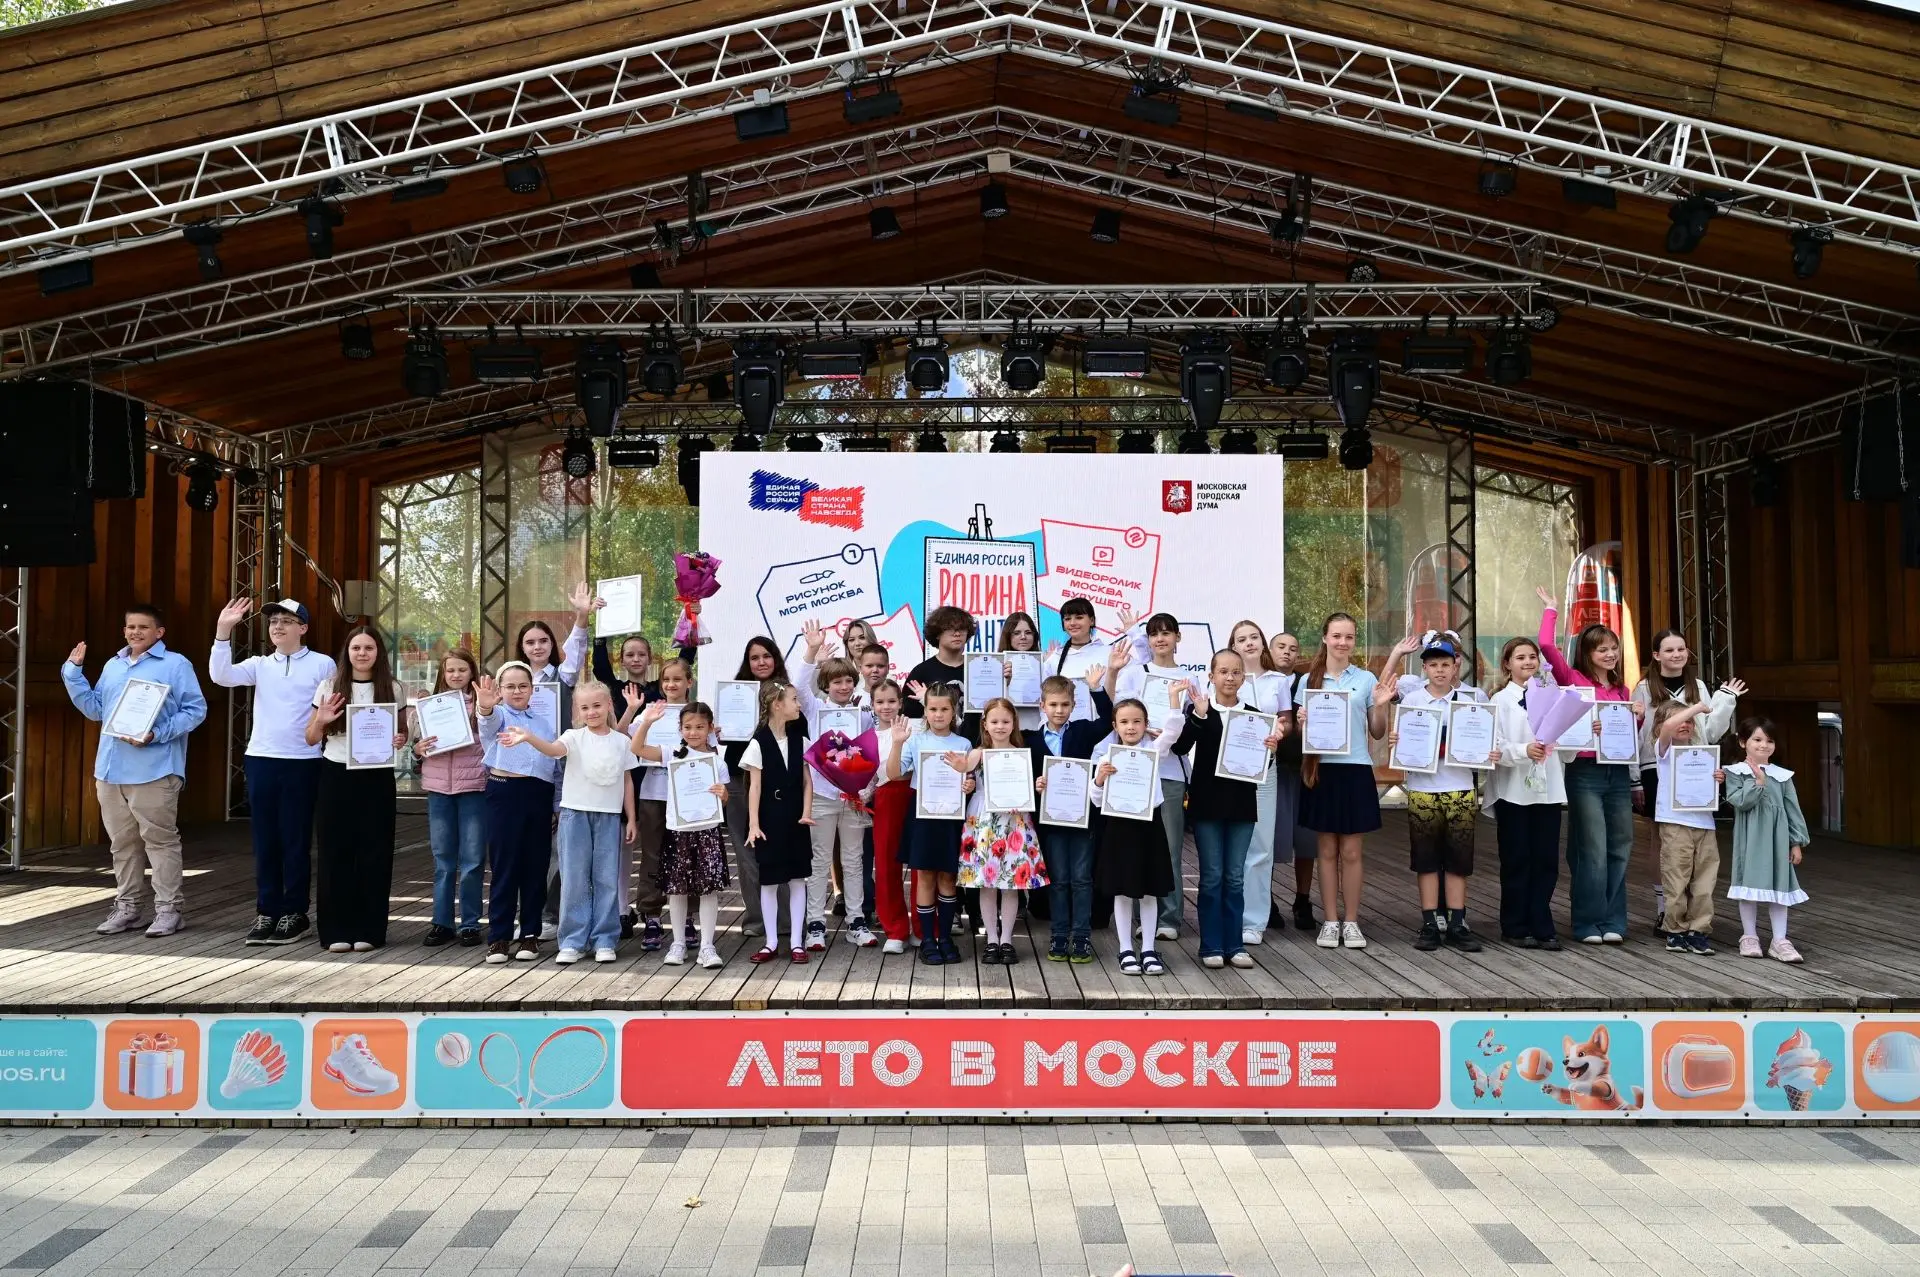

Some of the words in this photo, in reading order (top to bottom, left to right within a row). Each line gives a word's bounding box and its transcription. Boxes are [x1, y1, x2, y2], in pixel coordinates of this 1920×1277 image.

[1196, 483, 1247, 491] МОСКОВСКАЯ
[1196, 492, 1241, 501] ГОРОДСКАЯ
[1196, 502, 1219, 511] ДУМА
[934, 551, 980, 566] ЕДИНАЯ
[982, 553, 1025, 567] РОССИЯ
[1055, 565, 1142, 591] ВИДЕОРОЛИК
[785, 580, 847, 604] РИСУНОК
[940, 567, 1027, 617] РОДИНА
[1069, 579, 1124, 598] МОСКВА
[778, 603, 808, 617] МОЯ
[810, 587, 865, 608] МОСКВА
[18, 1049, 31, 1057] на
[33, 1047, 68, 1057] сайте:
[727, 1040, 922, 1087] ЛЕТО
[951, 1040, 995, 1086] В
[1024, 1040, 1336, 1087] МОСКВЕ
[0, 1067, 66, 1081] os.ru
